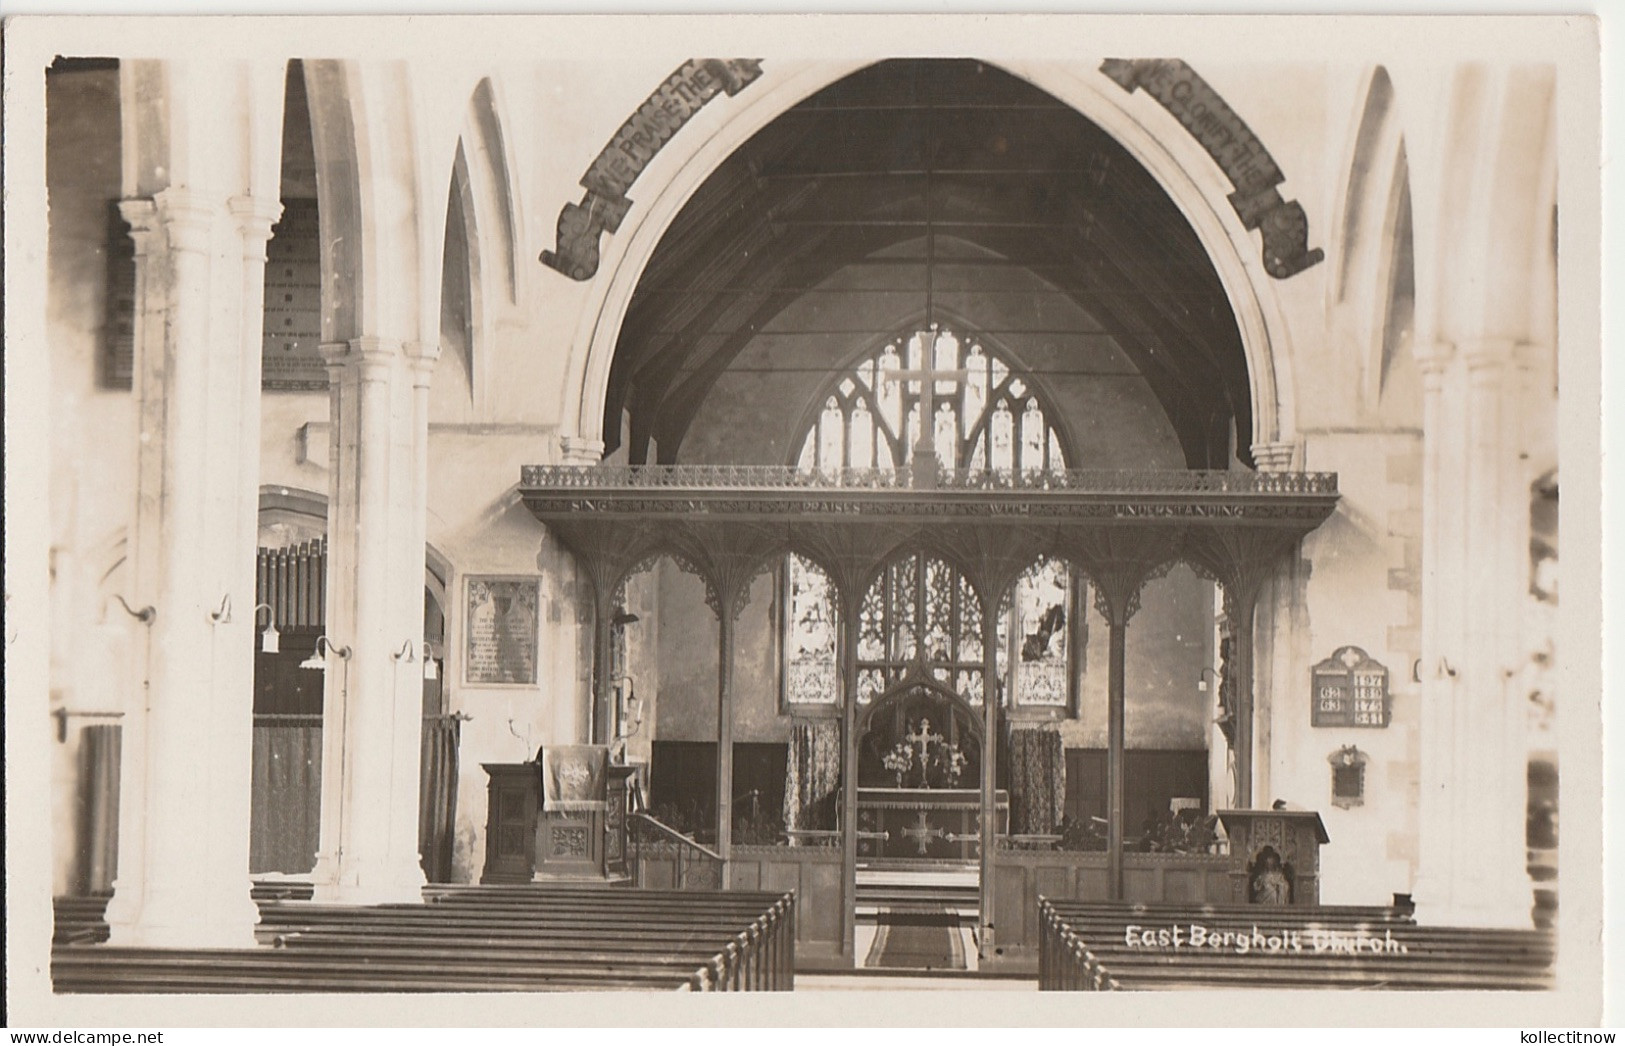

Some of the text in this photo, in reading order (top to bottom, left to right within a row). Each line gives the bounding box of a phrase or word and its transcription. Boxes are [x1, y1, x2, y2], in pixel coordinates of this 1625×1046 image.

[571, 500, 607, 513] SING
[803, 502, 860, 515] PRAISES
[990, 503, 1029, 517] WITH
[1115, 504, 1245, 518] UNDERSTANDING
